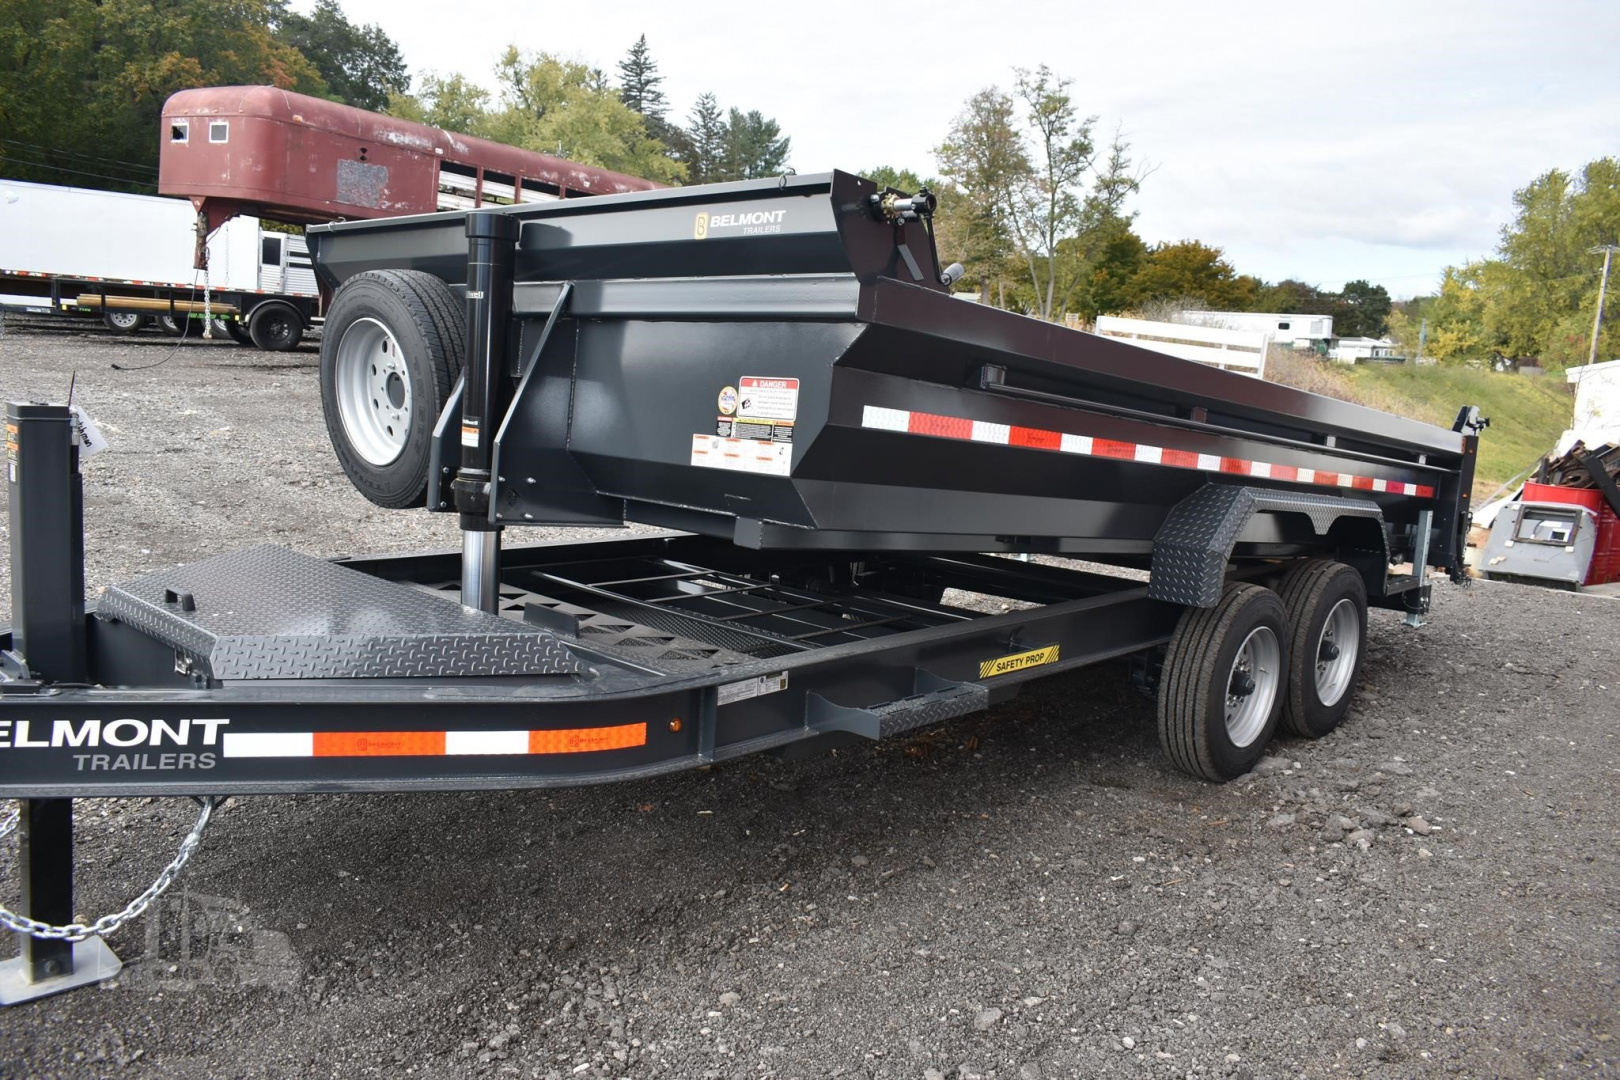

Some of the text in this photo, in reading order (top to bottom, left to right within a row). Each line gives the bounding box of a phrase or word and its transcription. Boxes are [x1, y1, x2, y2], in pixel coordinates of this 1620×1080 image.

[710, 210, 787, 228] BELMONT
[743, 224, 781, 235] TRAILERS
[760, 380, 787, 389] DANGER
[996, 652, 1045, 672] SAFETY PROP
[72, 752, 217, 771] TRAILERS
